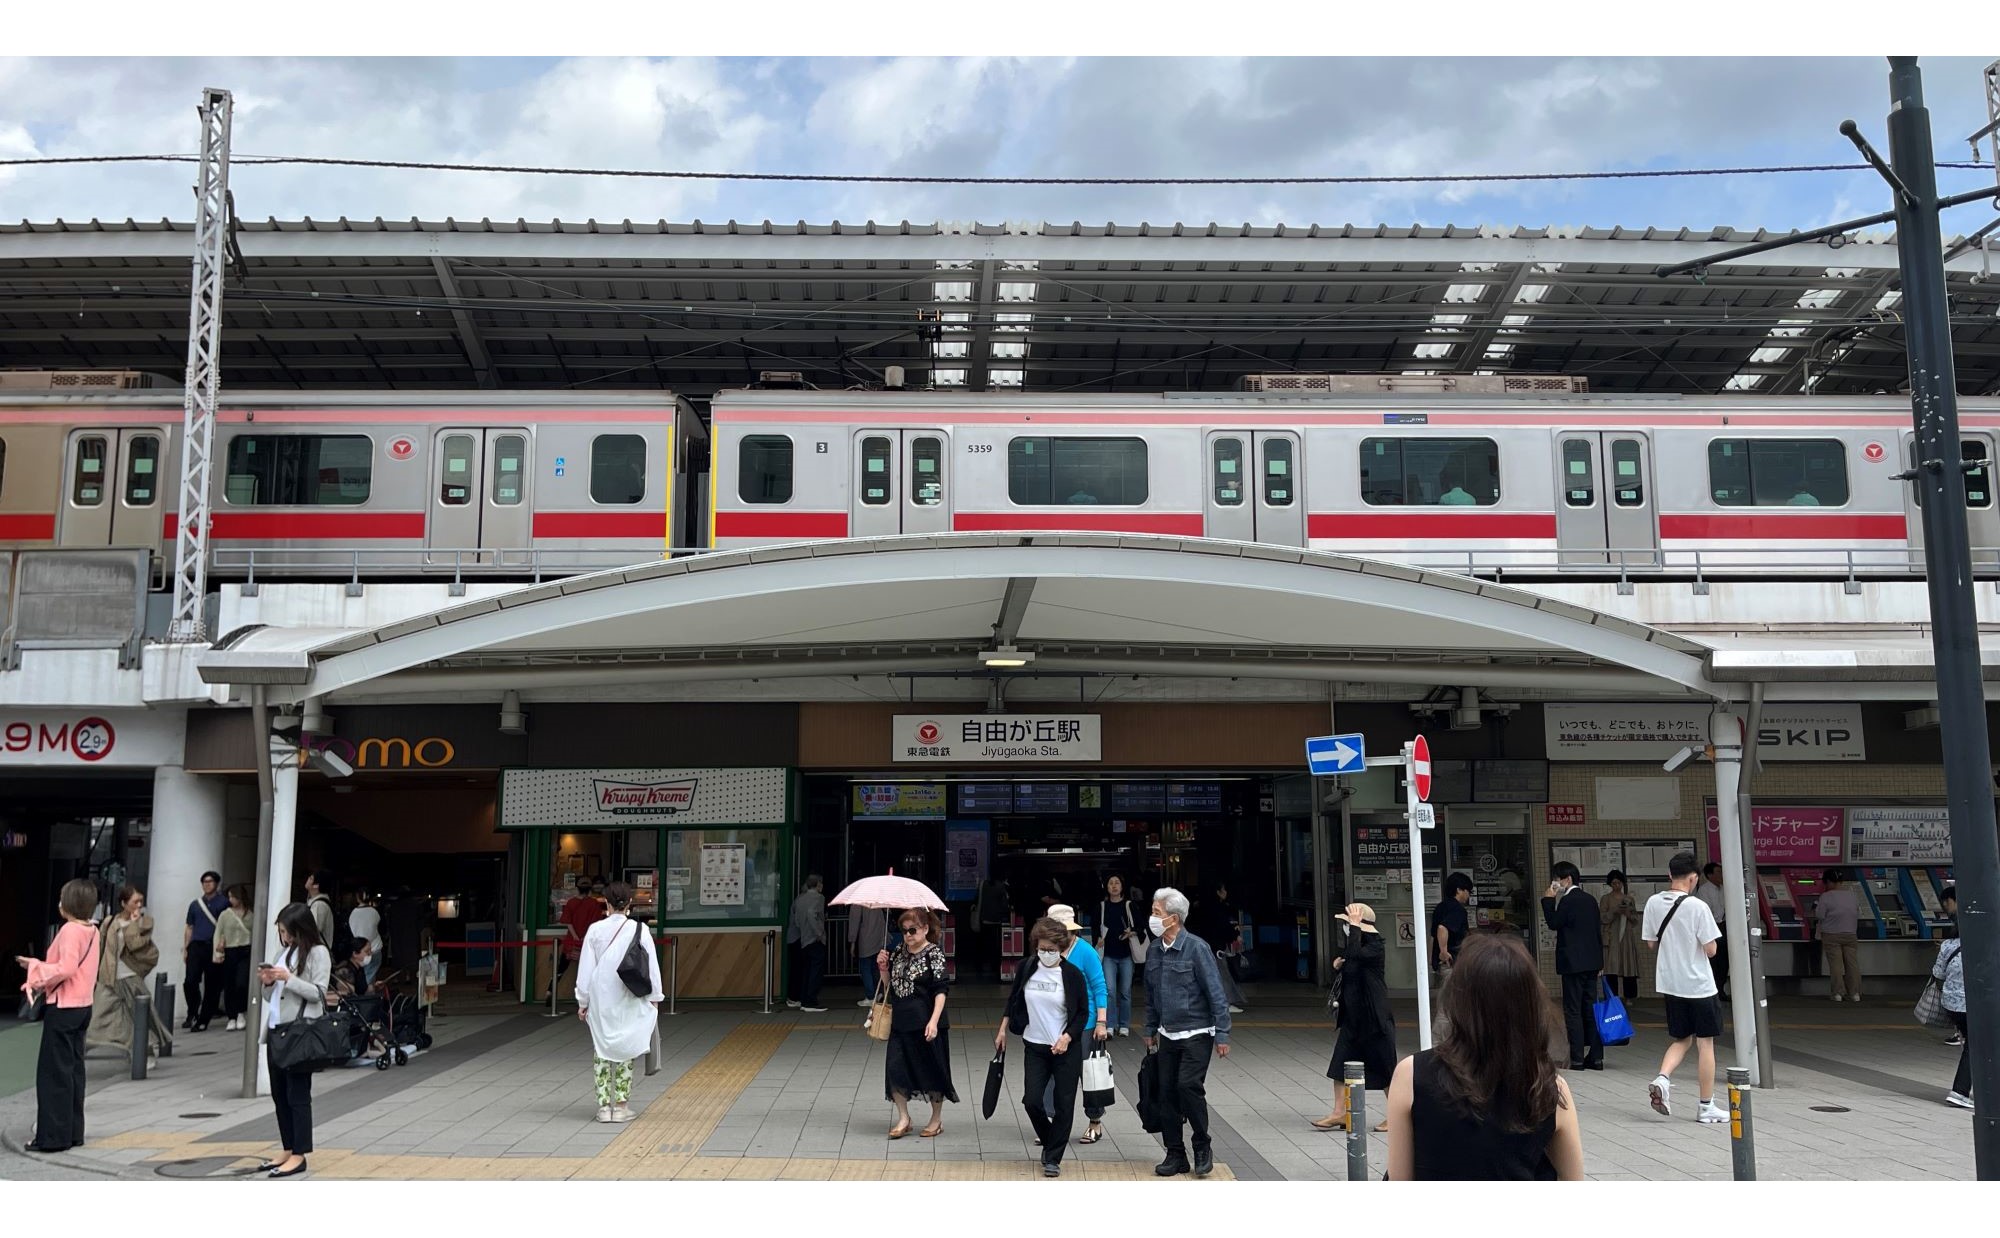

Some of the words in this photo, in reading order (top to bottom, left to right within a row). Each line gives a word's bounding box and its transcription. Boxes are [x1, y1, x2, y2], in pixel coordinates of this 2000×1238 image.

[968, 444, 992, 453] 5359
[962, 720, 1080, 743] 自由が丘駅
[1758, 729, 1851, 746] SKIP
[907, 747, 950, 757] 東急電鉄
[1041, 746, 1062, 756] Sta.
[602, 787, 648, 806] Krispy
[646, 787, 691, 804] Kreme
[1776, 836, 1787, 846] IC
[1790, 836, 1814, 846] Card
